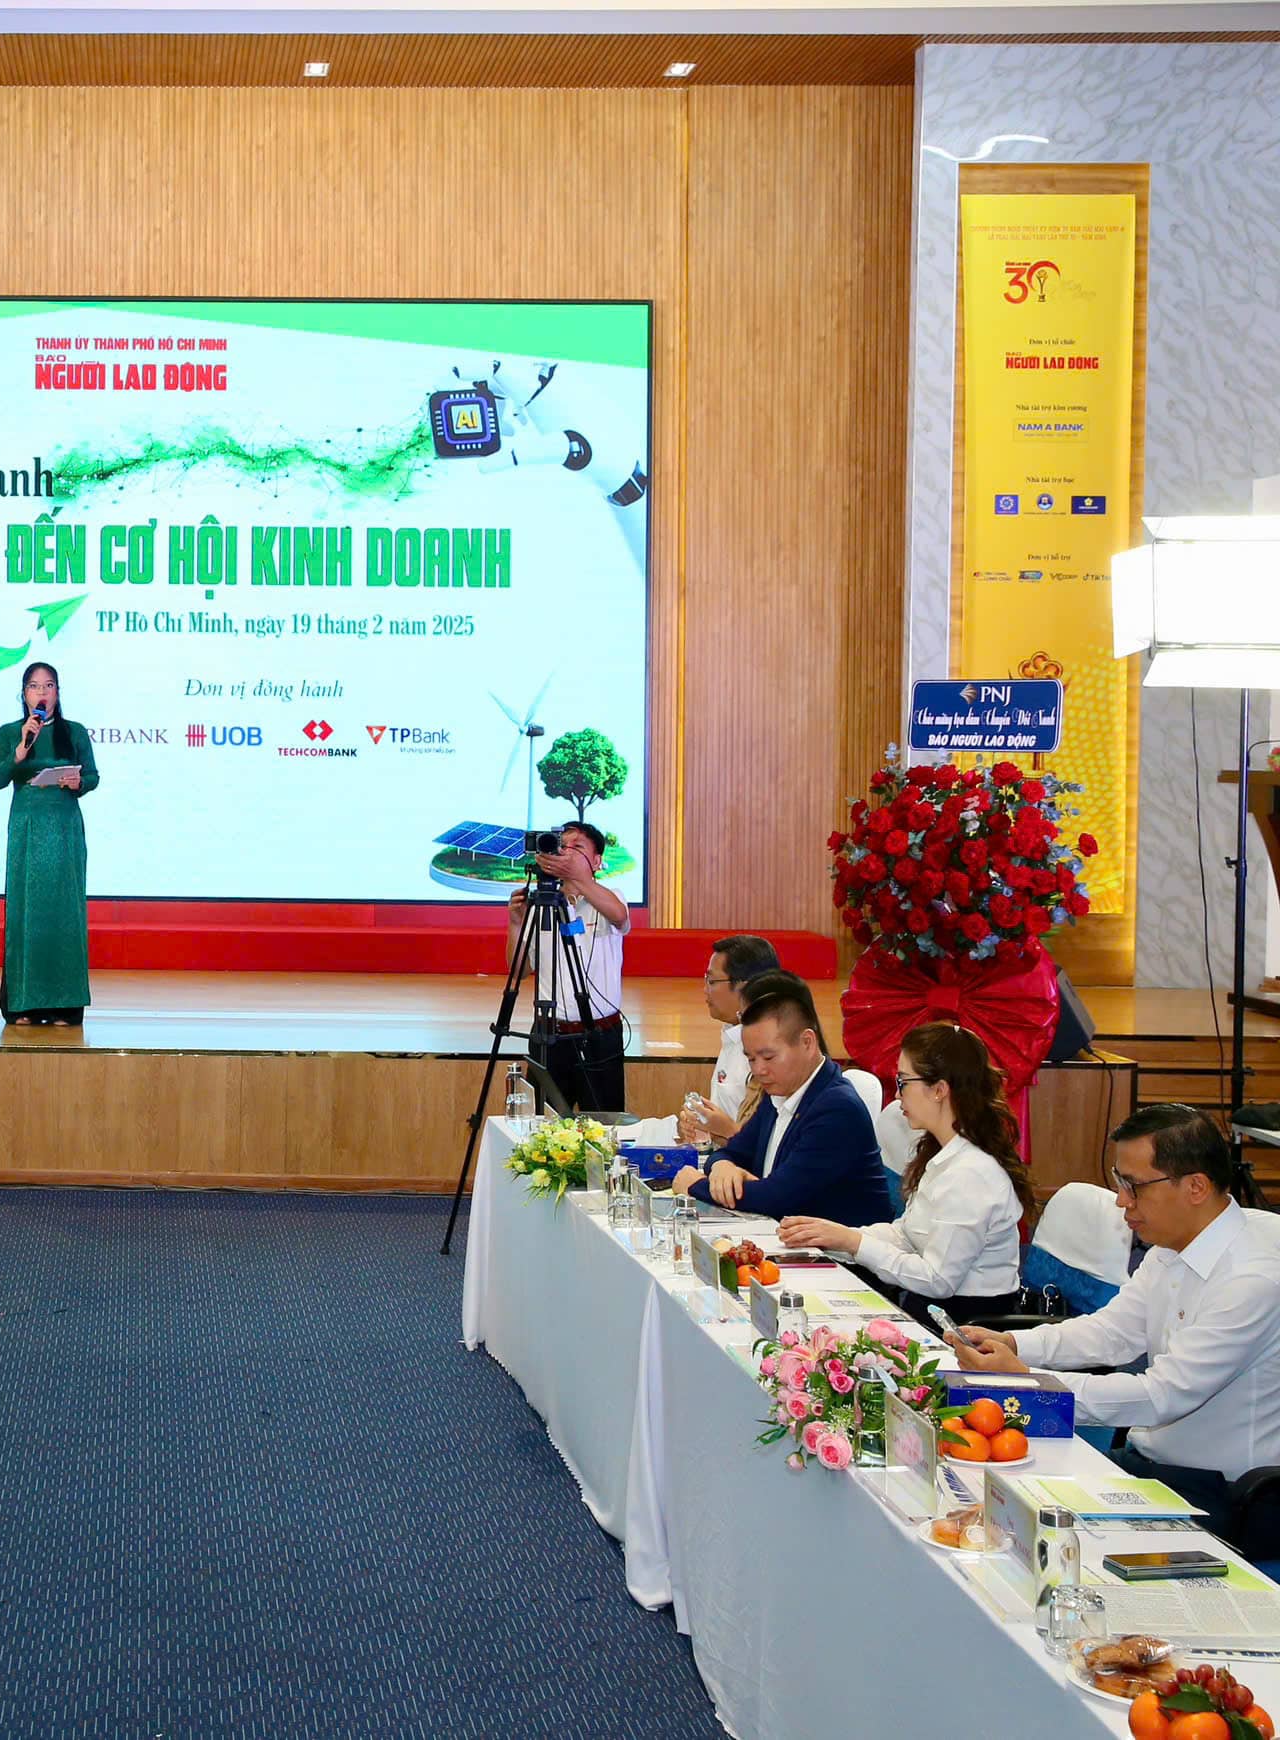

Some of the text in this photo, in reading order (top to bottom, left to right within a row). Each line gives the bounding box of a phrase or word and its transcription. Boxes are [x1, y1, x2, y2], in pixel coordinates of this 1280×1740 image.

[199, 338, 227, 351] MINH
[1043, 357, 1065, 369] LAO
[113, 364, 157, 390] LAO
[163, 362, 227, 392] ĐỘNG
[456, 409, 479, 430] AI
[4, 506, 86, 584] ĐẾN
[100, 518, 158, 585] CƠ
[168, 514, 238, 600] HỘI
[251, 526, 353, 586] KINH
[366, 527, 512, 588] DOANH
[96, 610, 120, 632] TP
[154, 611, 184, 632] Chí
[188, 612, 238, 635] Minh,
[245, 615, 286, 638] ngày
[292, 613, 311, 634] 19
[316, 612, 368, 640] tháng
[372, 614, 383, 635] 2
[389, 616, 426, 635] năm
[432, 614, 474, 636] 2025
[184, 678, 224, 697] Đơn
[230, 680, 246, 700] vị
[300, 679, 344, 698] hành
[980, 686, 1012, 706] PNJ
[212, 726, 263, 746] UOB
[389, 728, 451, 744] TPBank
[928, 732, 1036, 749] BÁO NGƯỜI LAO ĐỘNG
[278, 747, 358, 758] TECHCOMBANK
